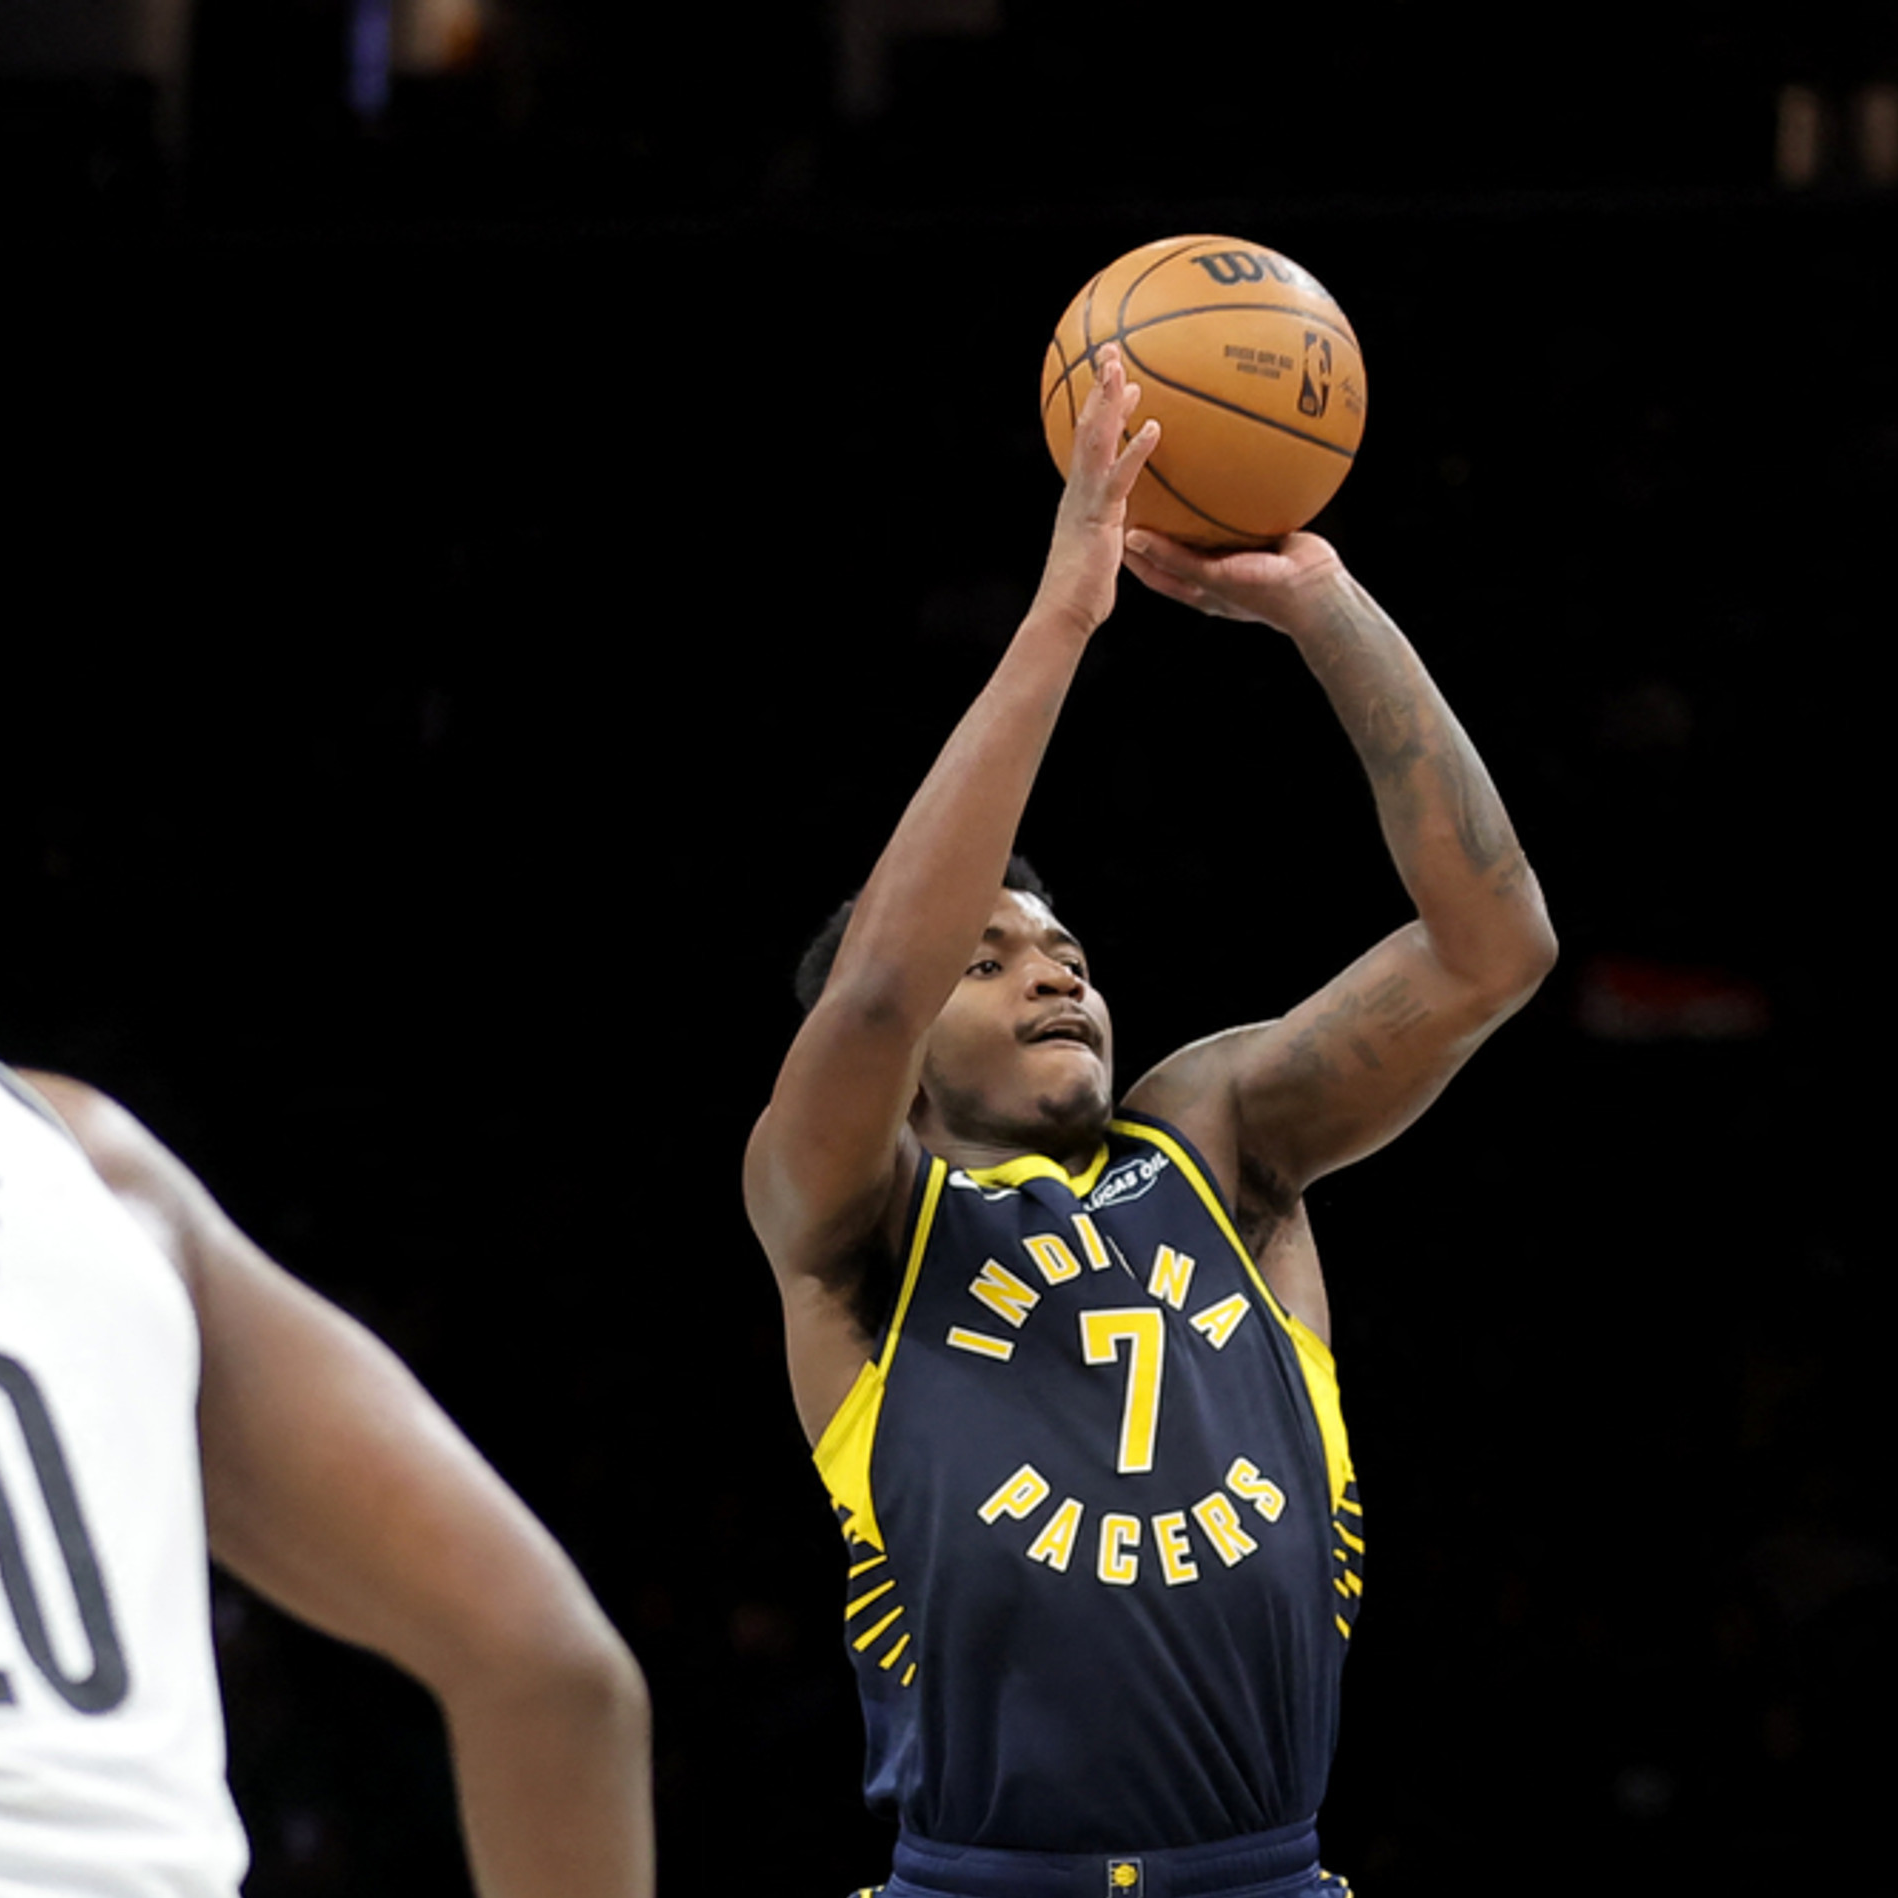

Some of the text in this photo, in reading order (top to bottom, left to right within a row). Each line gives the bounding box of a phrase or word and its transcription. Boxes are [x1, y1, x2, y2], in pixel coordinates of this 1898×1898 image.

[1139, 1151, 1170, 1180] OIL
[946, 1212, 1251, 1362] INDINA
[1080, 1306, 1165, 1475] 7
[978, 1457, 1286, 1586] PACERS
